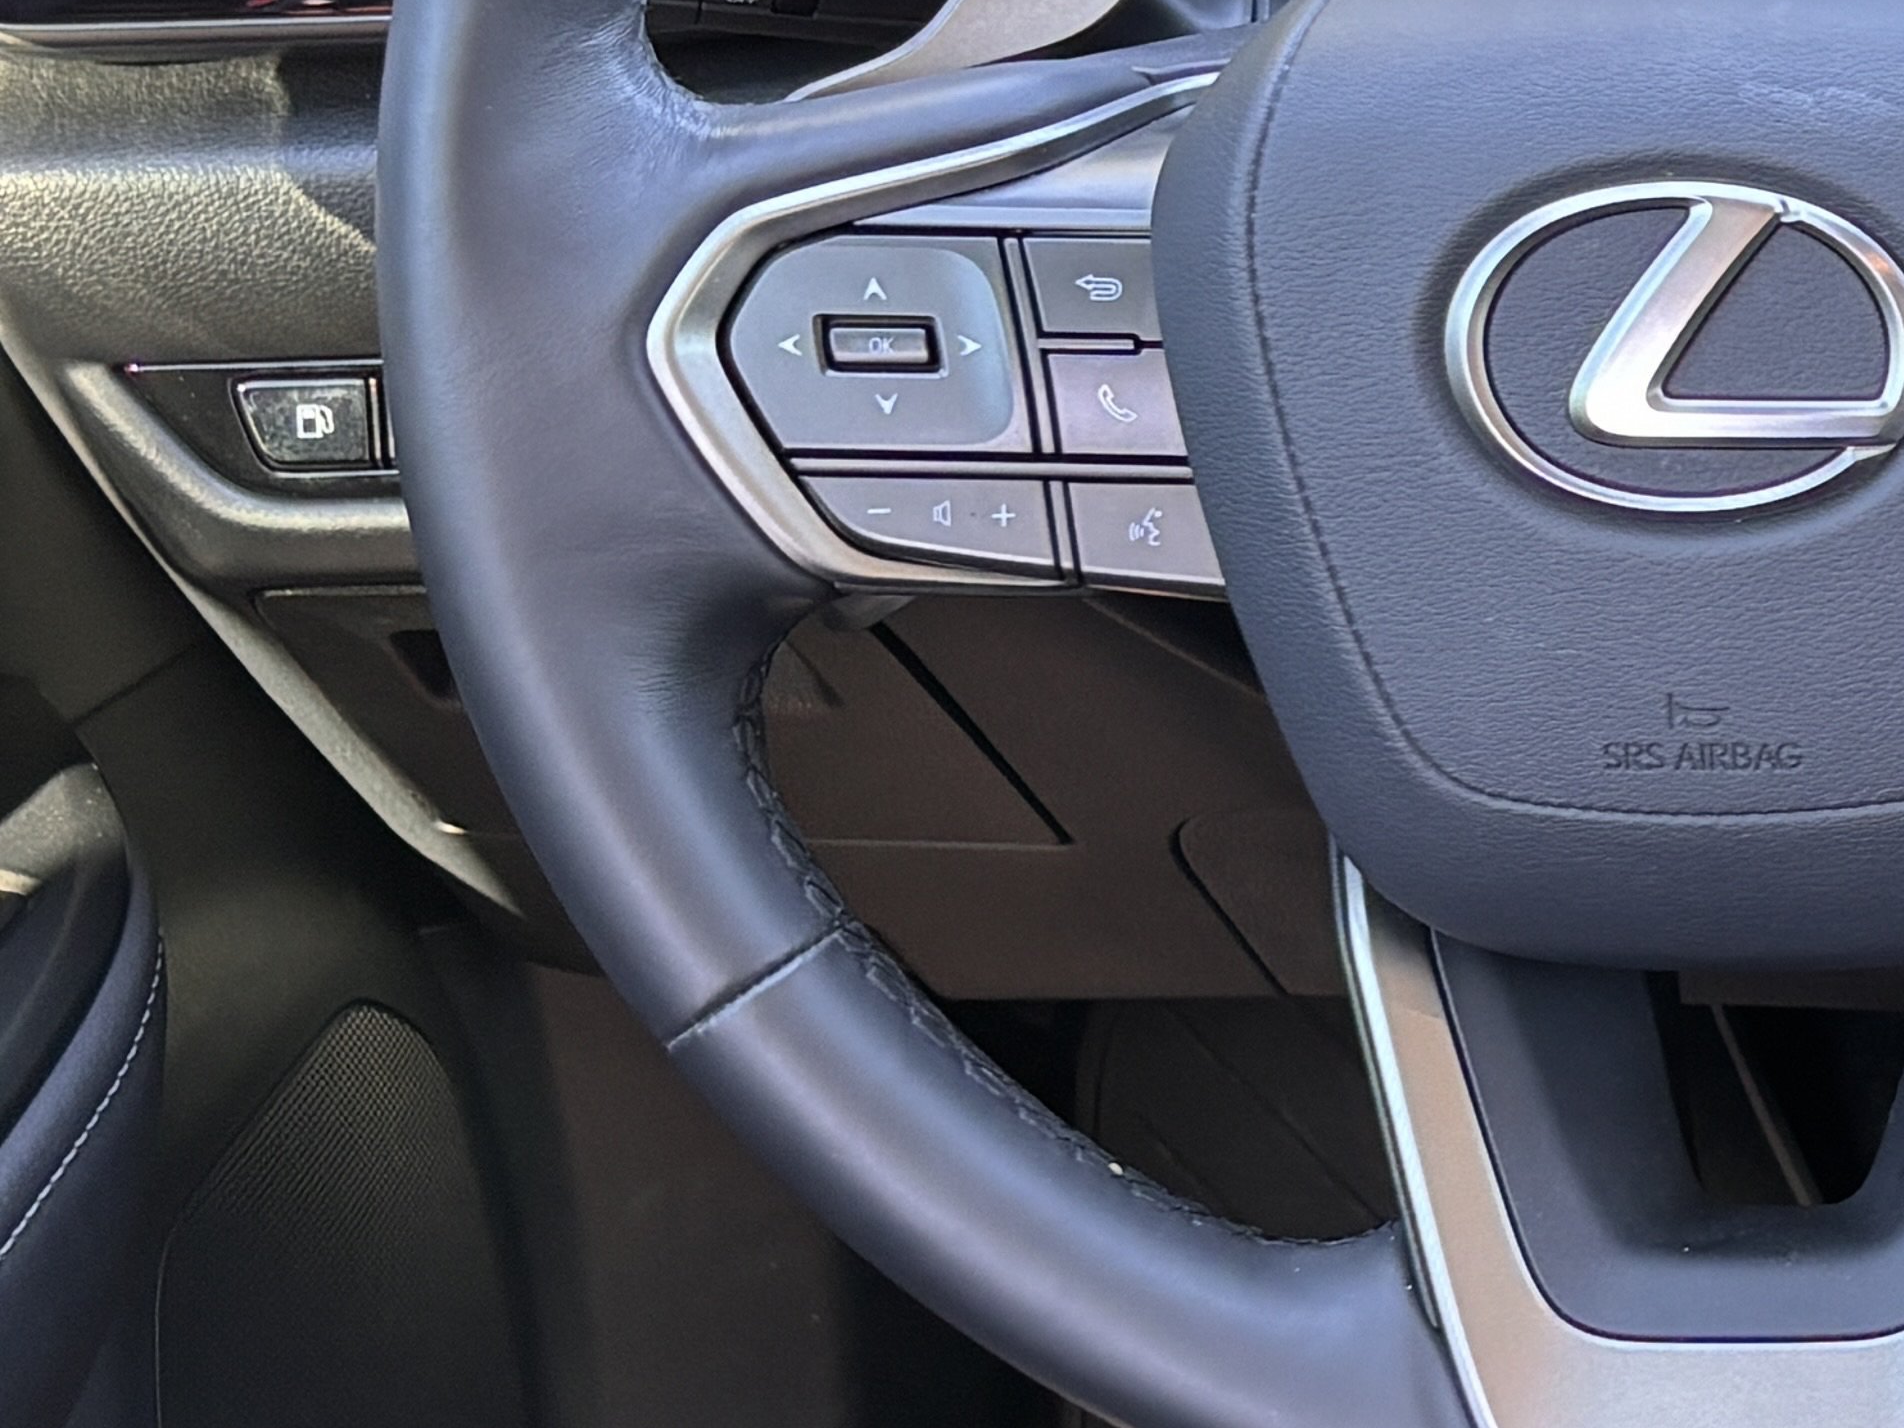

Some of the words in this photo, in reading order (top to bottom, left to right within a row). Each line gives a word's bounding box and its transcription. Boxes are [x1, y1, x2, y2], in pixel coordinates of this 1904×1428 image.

[869, 336, 895, 355] OK
[1602, 741, 1665, 771] SRS
[1674, 741, 1804, 771] AIRBAG
